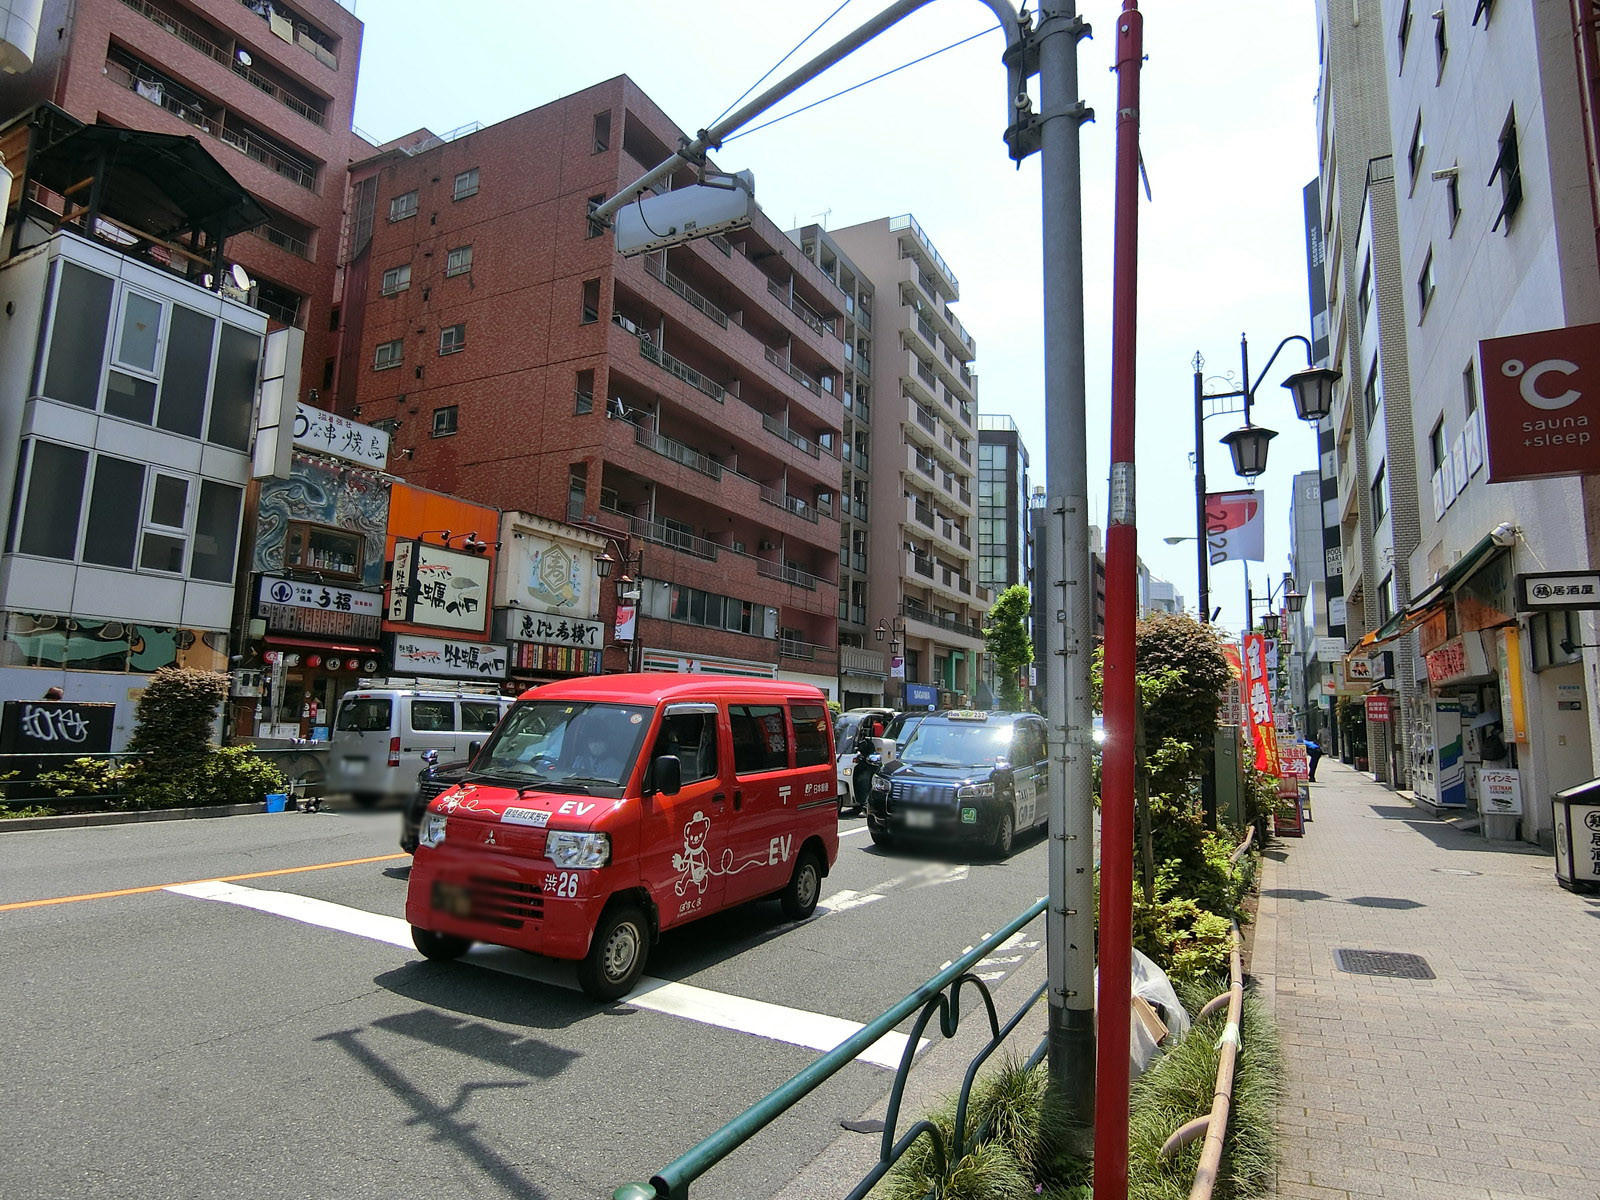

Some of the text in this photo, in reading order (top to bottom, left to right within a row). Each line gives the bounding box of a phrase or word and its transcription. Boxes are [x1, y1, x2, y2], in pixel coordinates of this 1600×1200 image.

[1522, 415, 1588, 432] sauna
[1523, 432, 1590, 446] +sleep
[1206, 511, 1228, 566] 2020
[314, 588, 352, 611] う福
[520, 614, 599, 645] 恵比寿横丁
[444, 643, 506, 676] 牡蠣ベロ
[1483, 775, 1518, 783] バインミー
[559, 801, 595, 816] EV
[768, 834, 792, 866] EV
[544, 872, 579, 898] 渋26
